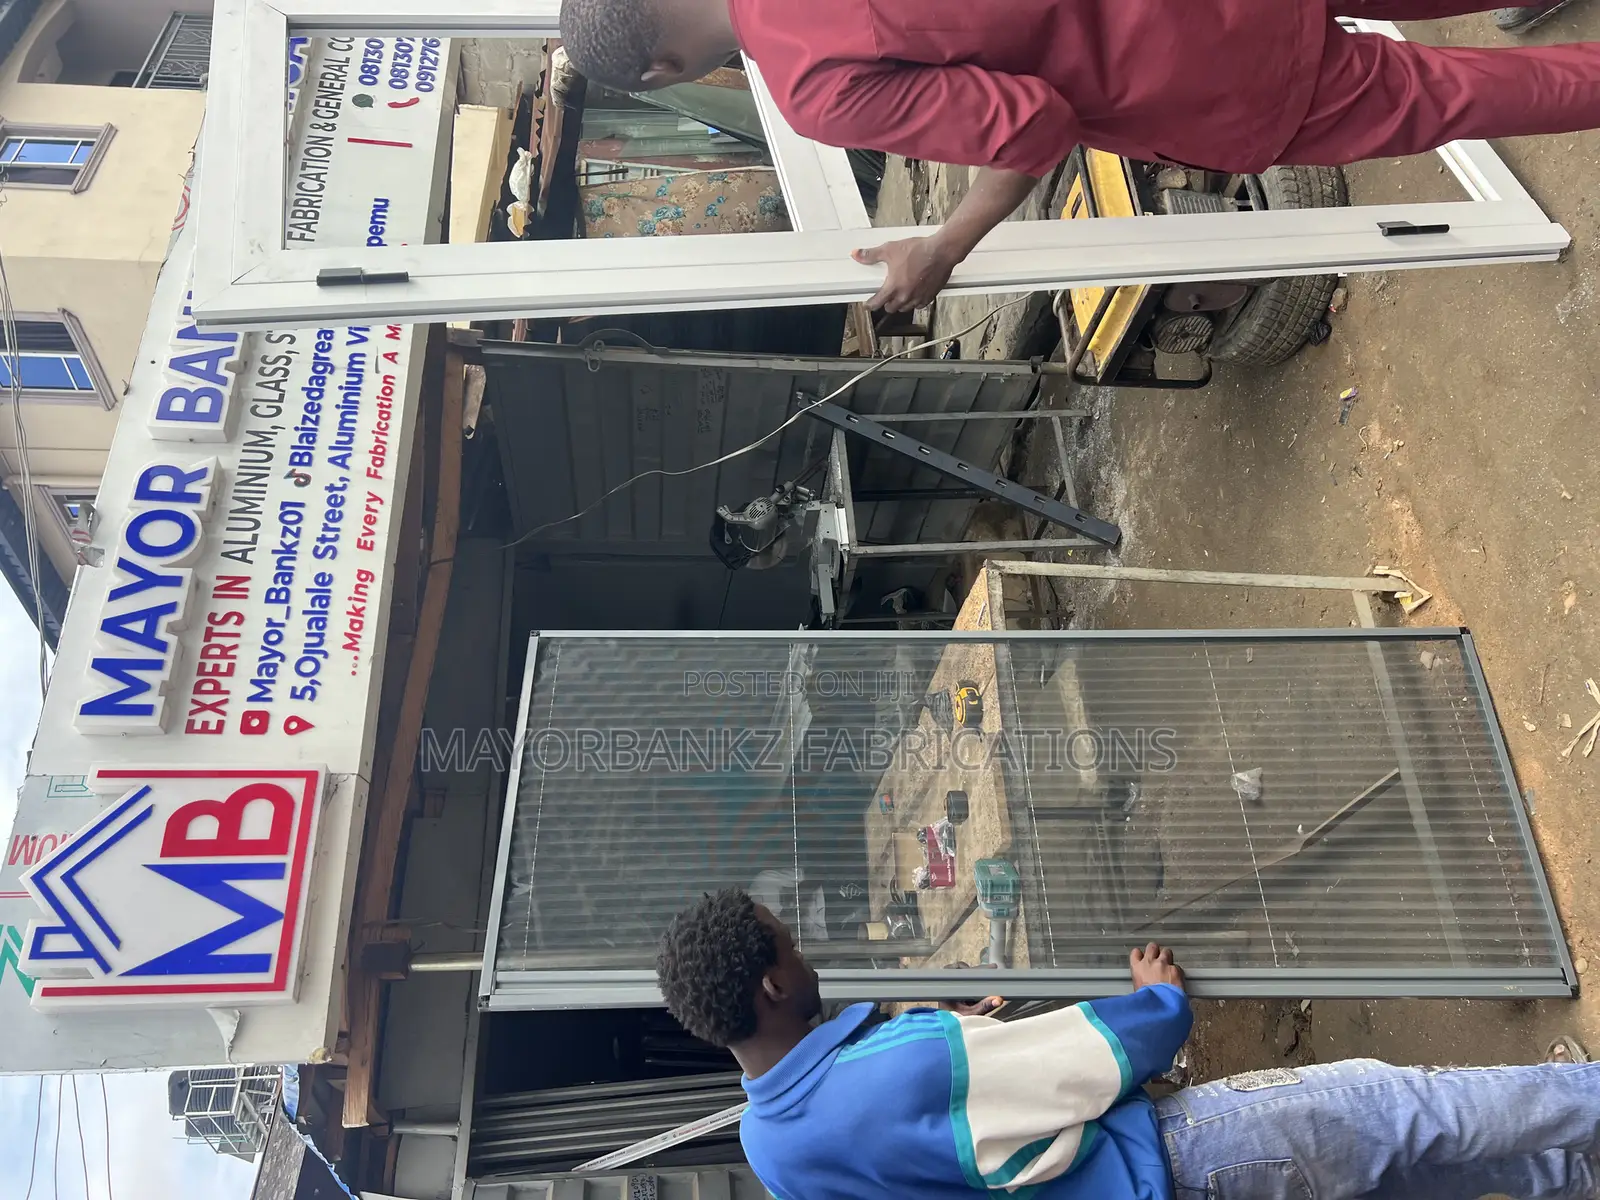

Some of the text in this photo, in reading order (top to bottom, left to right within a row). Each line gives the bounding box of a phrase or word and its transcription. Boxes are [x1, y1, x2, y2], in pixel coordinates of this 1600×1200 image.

[312, 57, 350, 119] GENERAL
[358, 38, 385, 86] 08130
[311, 121, 337, 132] &
[287, 135, 335, 242] FABRICATION
[250, 350, 300, 418] GLASS,
[383, 352, 399, 365] A
[327, 353, 367, 470] Aluminium
[366, 375, 396, 480] Fabrication
[220, 425, 286, 565] ALUMINIUM,
[246, 328, 335, 703] Mayor_Bankz01 Blaizedagrea
[312, 476, 351, 560] Street,
[357, 491, 384, 551] Every
[79, 464, 208, 716] MAYOR
[212, 575, 252, 600] IN
[185, 611, 245, 735] EXPERTS
